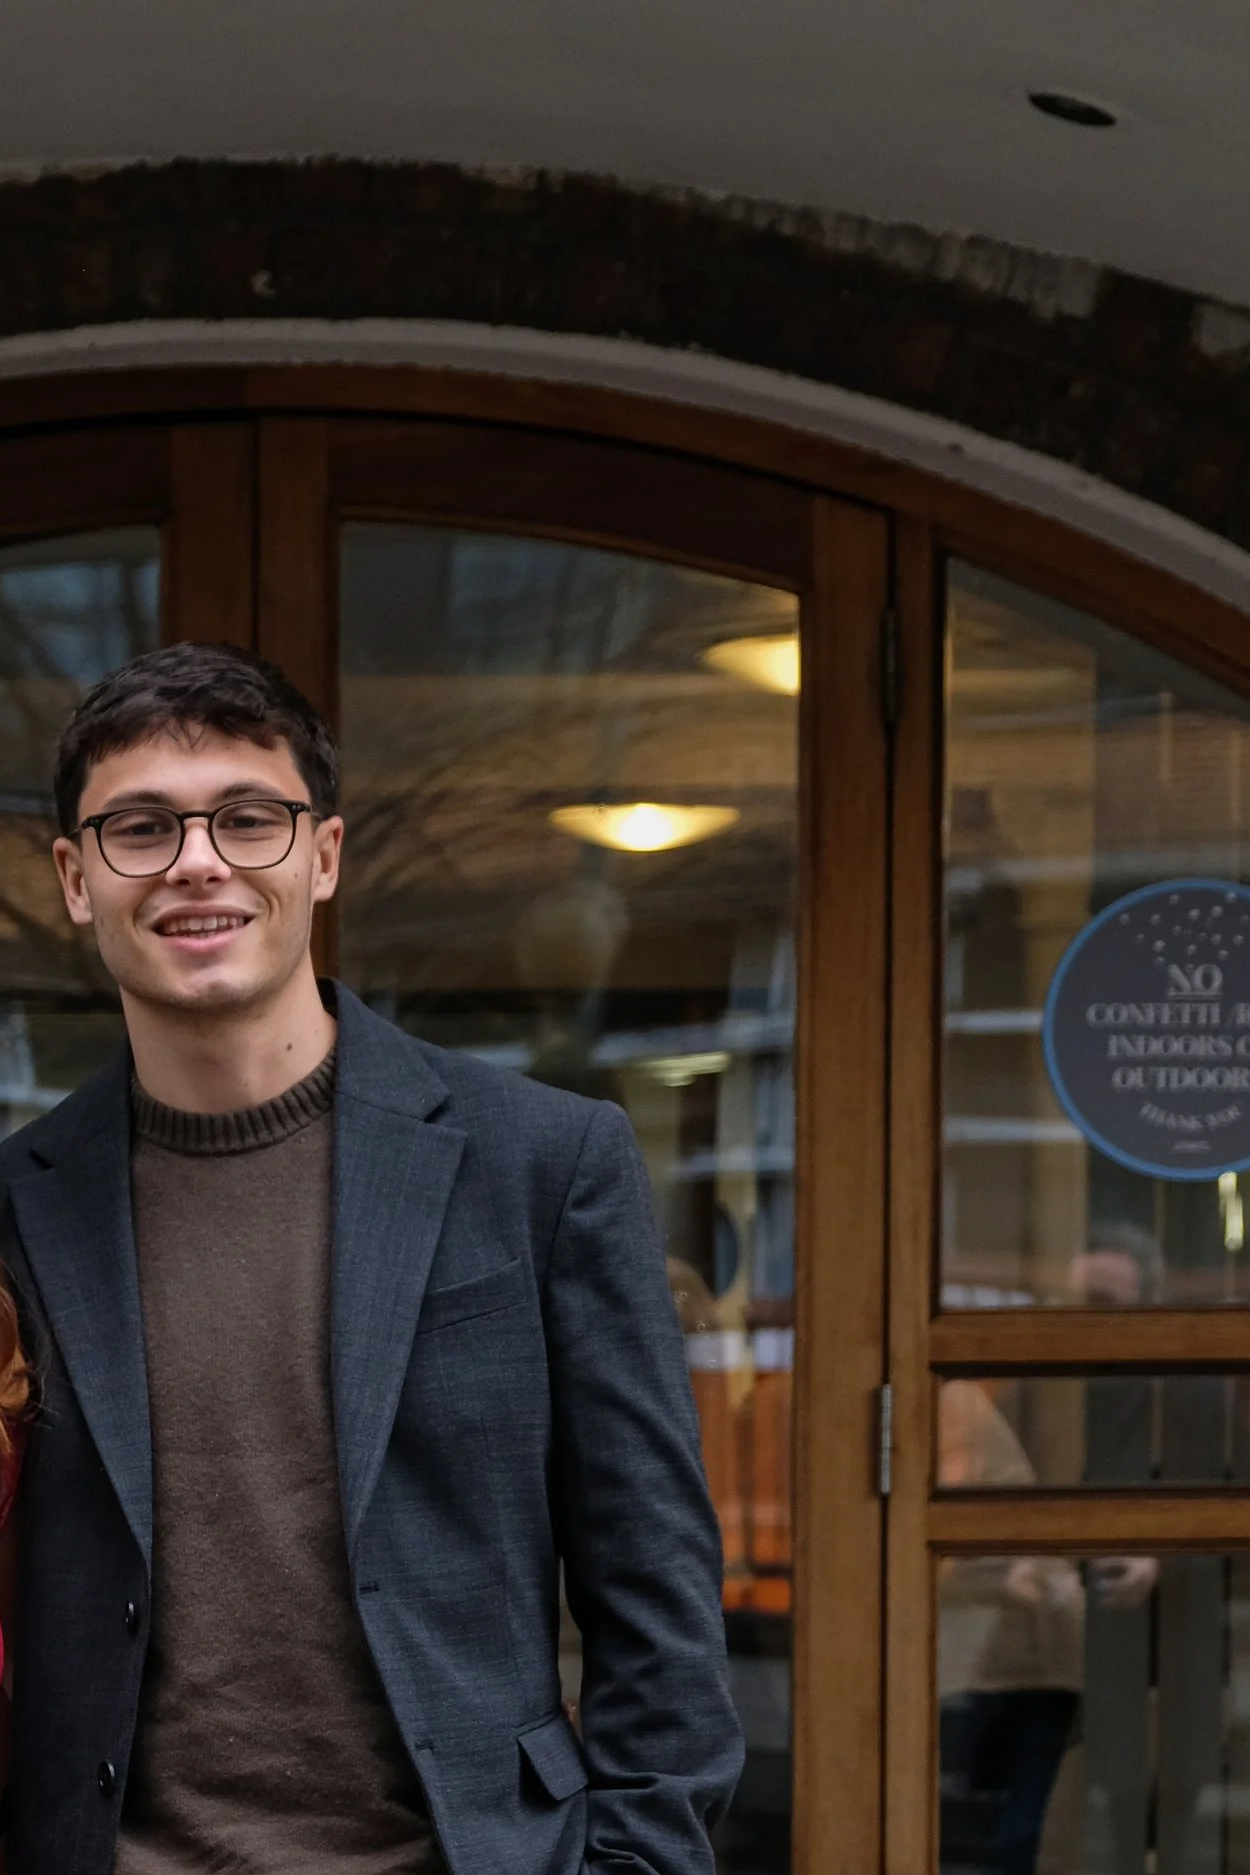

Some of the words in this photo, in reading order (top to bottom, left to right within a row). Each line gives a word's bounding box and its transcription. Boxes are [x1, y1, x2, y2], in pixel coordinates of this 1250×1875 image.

[1166, 964, 1223, 994] NO
[1085, 1003, 1220, 1026] CONFETTI
[1106, 1035, 1234, 1059] INDOORS
